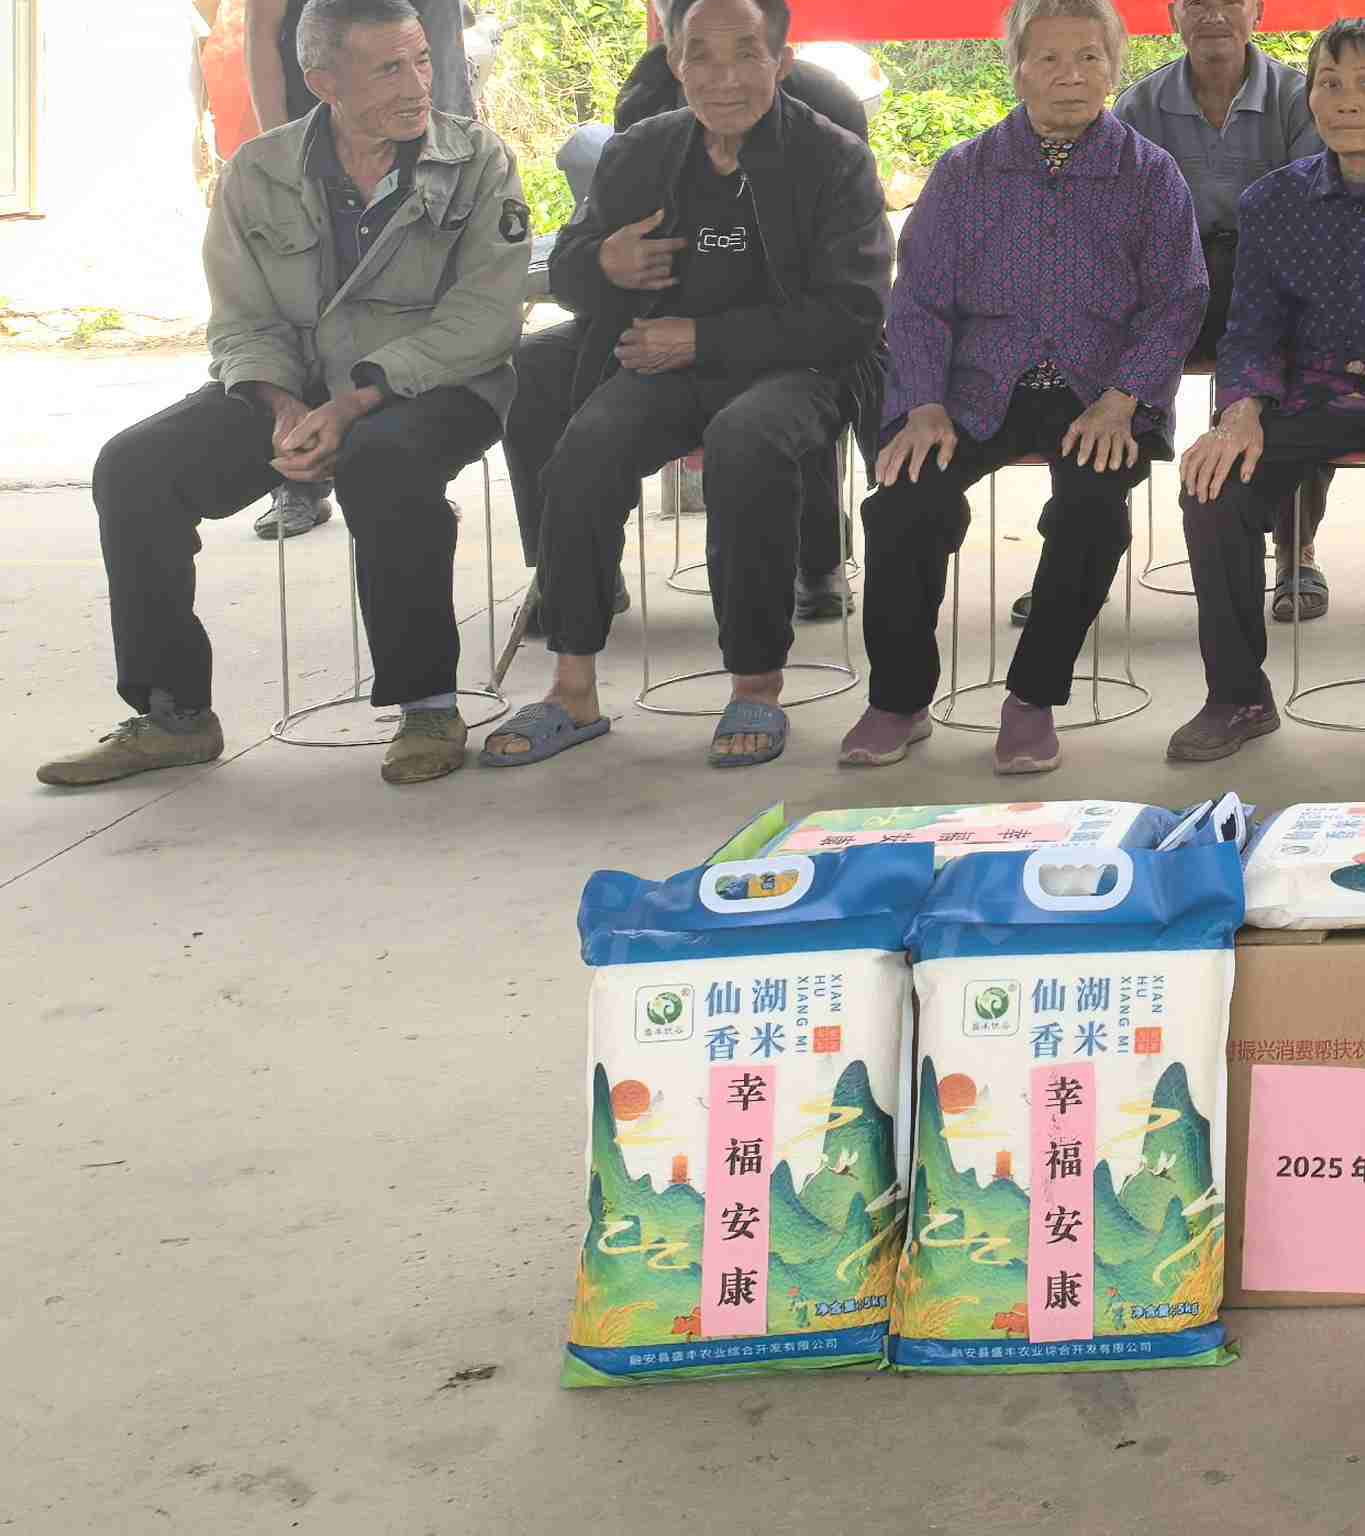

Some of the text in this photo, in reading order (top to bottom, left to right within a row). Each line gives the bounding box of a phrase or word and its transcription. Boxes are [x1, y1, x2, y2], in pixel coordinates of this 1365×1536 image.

[704, 977, 788, 1016] 仙湖
[796, 975, 809, 1027] XIANG
[814, 975, 825, 997] HU
[829, 974, 842, 1012] XIAN
[1031, 976, 1111, 1013] 仙湖
[1119, 975, 1132, 1028] XIANG
[1136, 976, 1148, 998] HU
[1151, 975, 1164, 1013] XIAN
[703, 1022, 786, 1061] 香米
[1029, 1020, 1107, 1058] 香米
[1275, 1154, 1344, 1179] 2025
[718, 1073, 767, 1306] 幸福安康
[1044, 1076, 1083, 1310] 幸福安康
